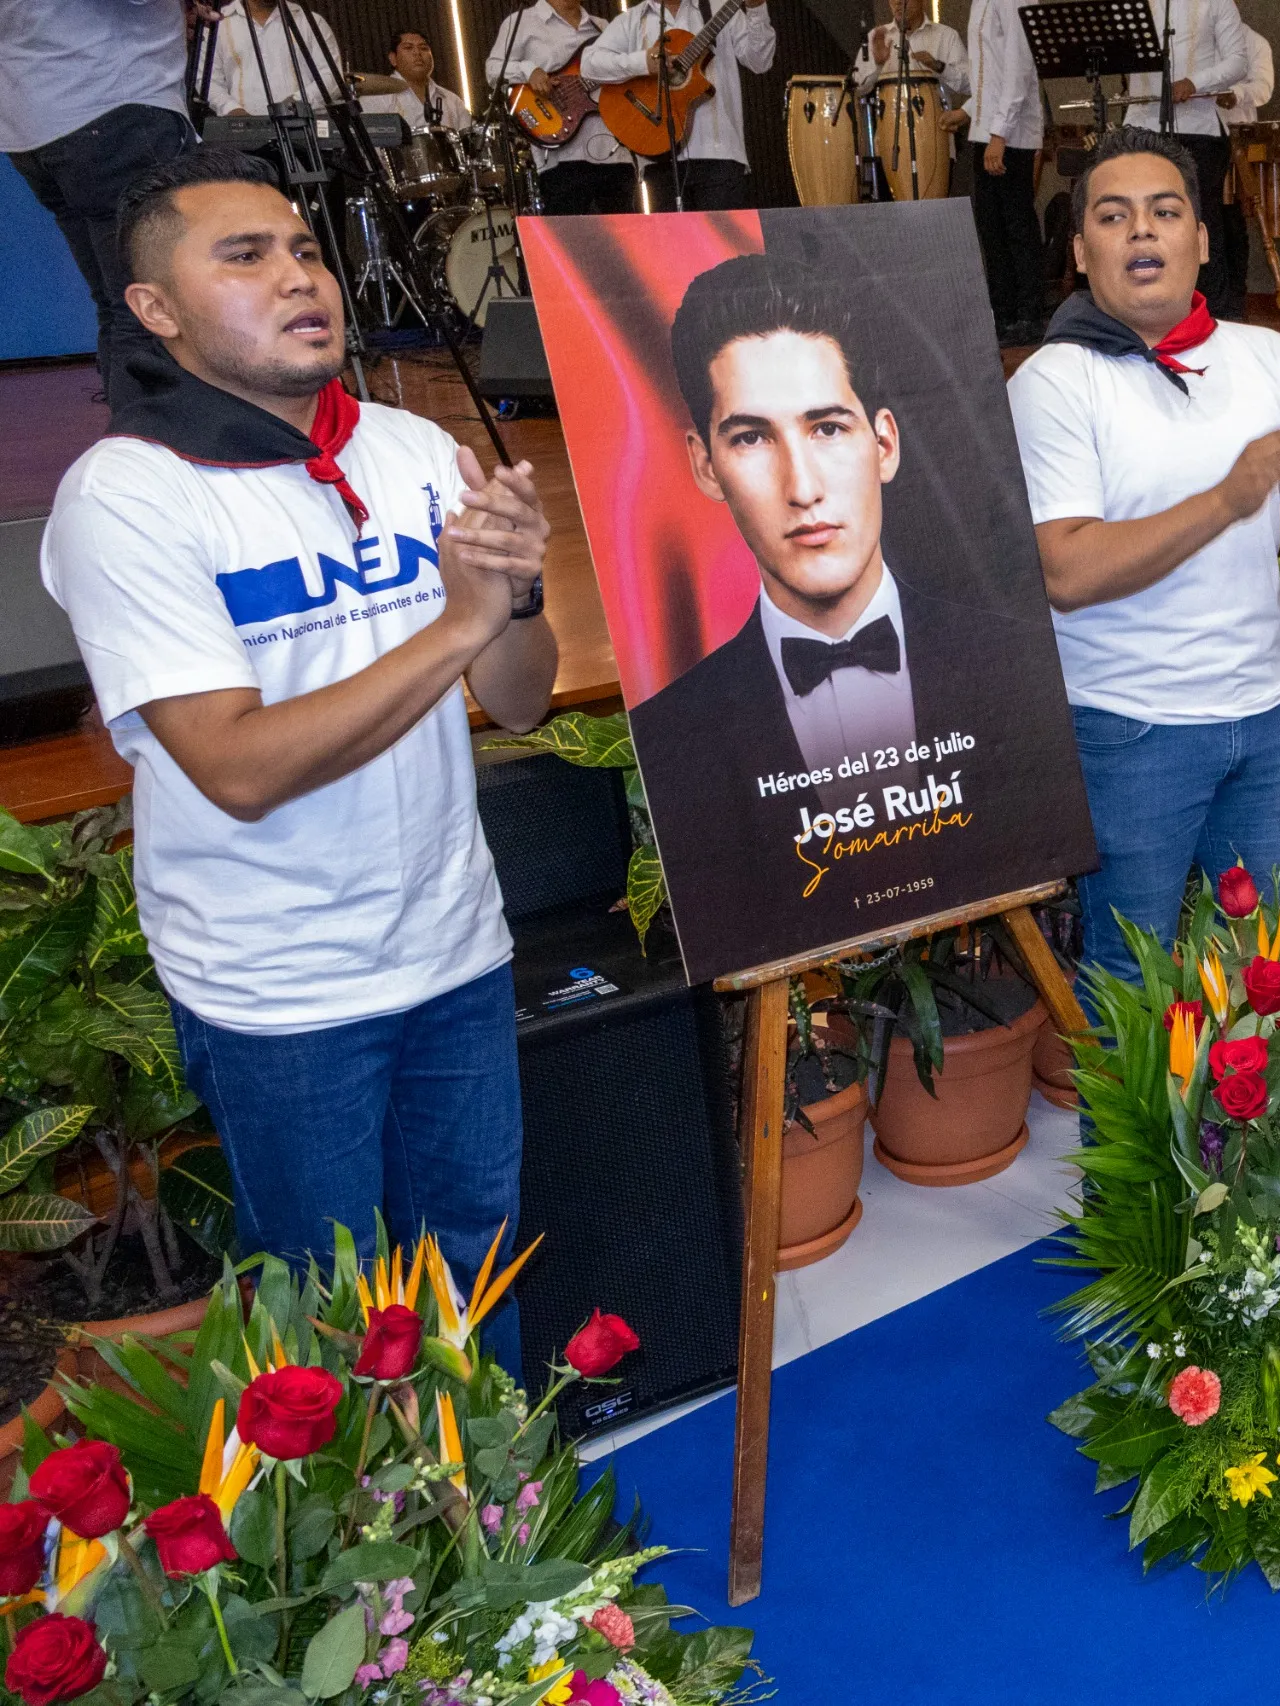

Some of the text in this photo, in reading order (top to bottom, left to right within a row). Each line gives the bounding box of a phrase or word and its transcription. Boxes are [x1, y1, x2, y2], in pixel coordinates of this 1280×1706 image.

[242, 633, 278, 647] nión
[281, 616, 334, 640] Nacional
[335, 613, 347, 626] de
[414, 591, 429, 604] de
[757, 731, 976, 798] Héroes del 23 de julio
[793, 770, 964, 845] José Rubí
[796, 791, 973, 898] Somarriba
[866, 876, 935, 905] 23-07-1959
[569, 967, 595, 979] 6
[585, 1392, 632, 1418] QSC
